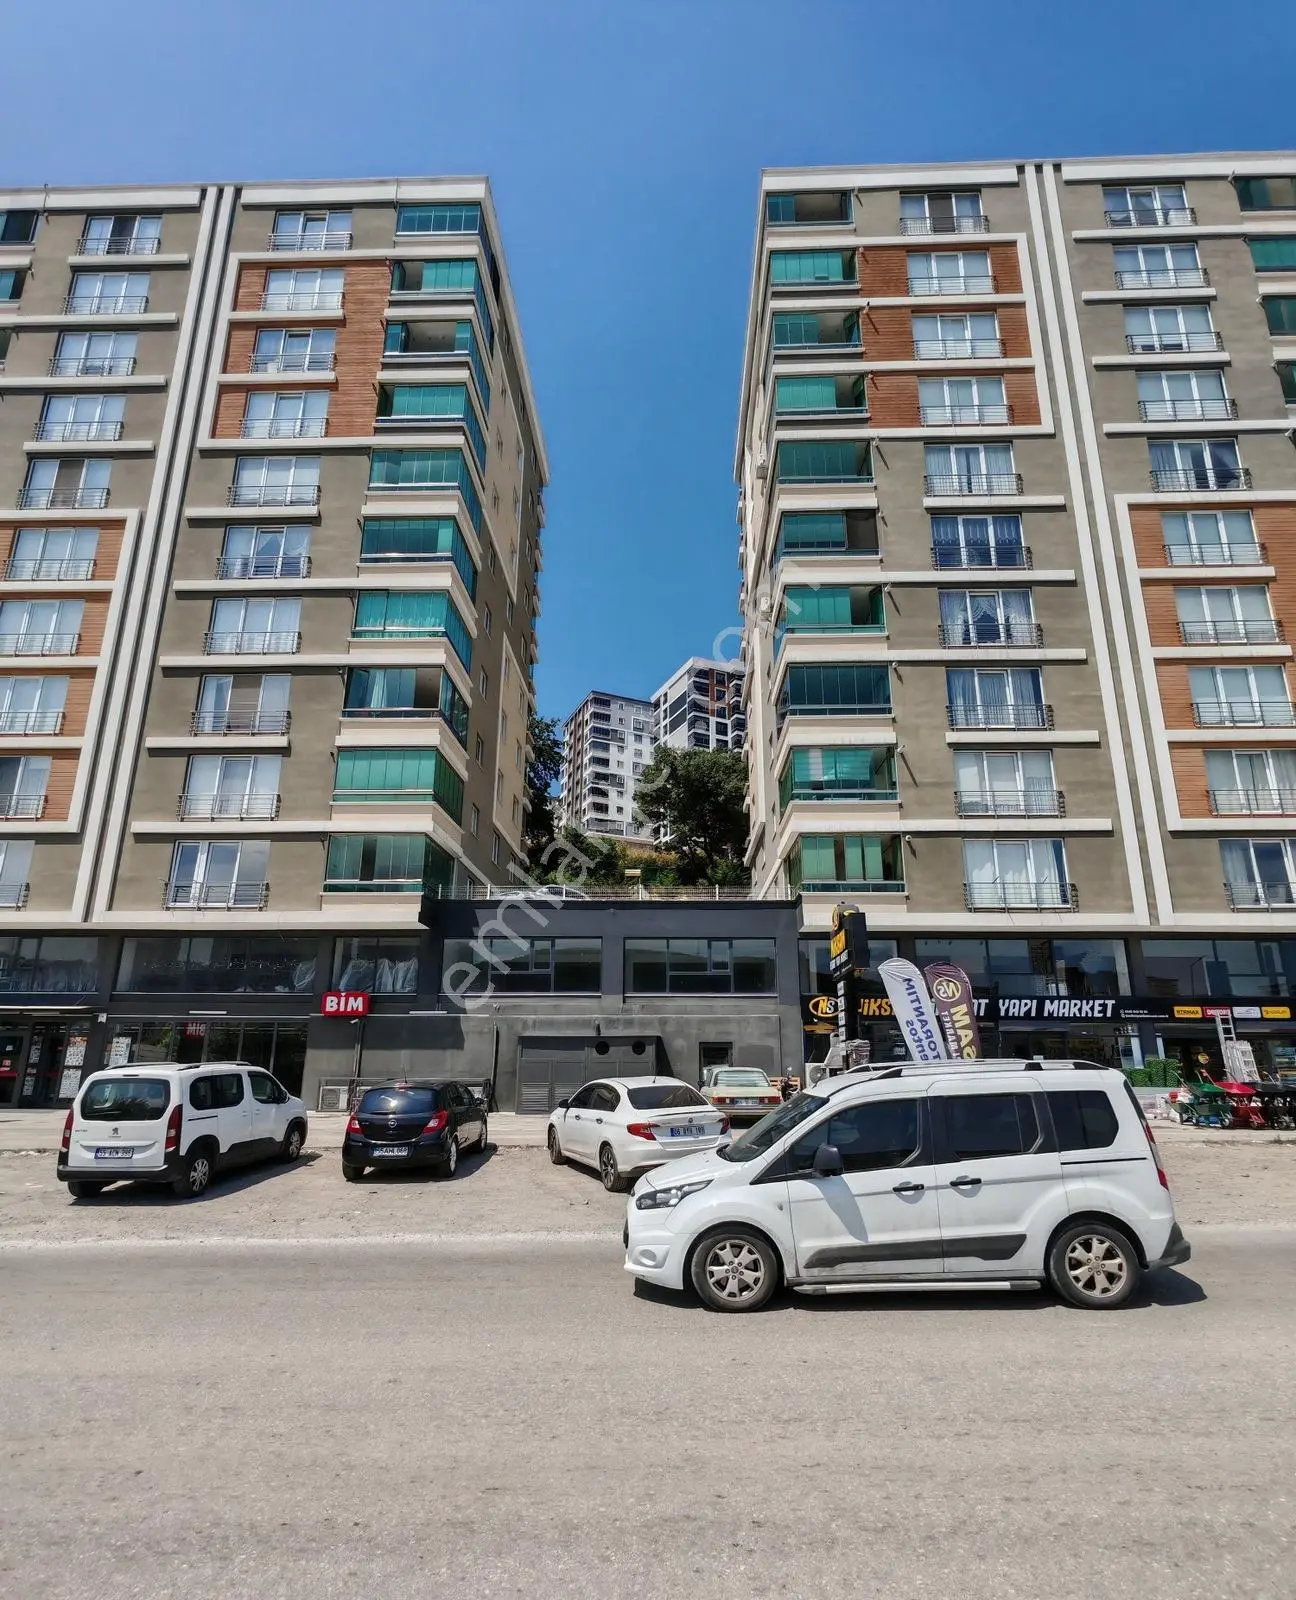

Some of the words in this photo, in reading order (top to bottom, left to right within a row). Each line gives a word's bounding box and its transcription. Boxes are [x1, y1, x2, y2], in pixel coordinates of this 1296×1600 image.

[326, 993, 363, 1011] BİM
[998, 999, 1037, 1017] YAPI
[1043, 999, 1116, 1017] MARKET
